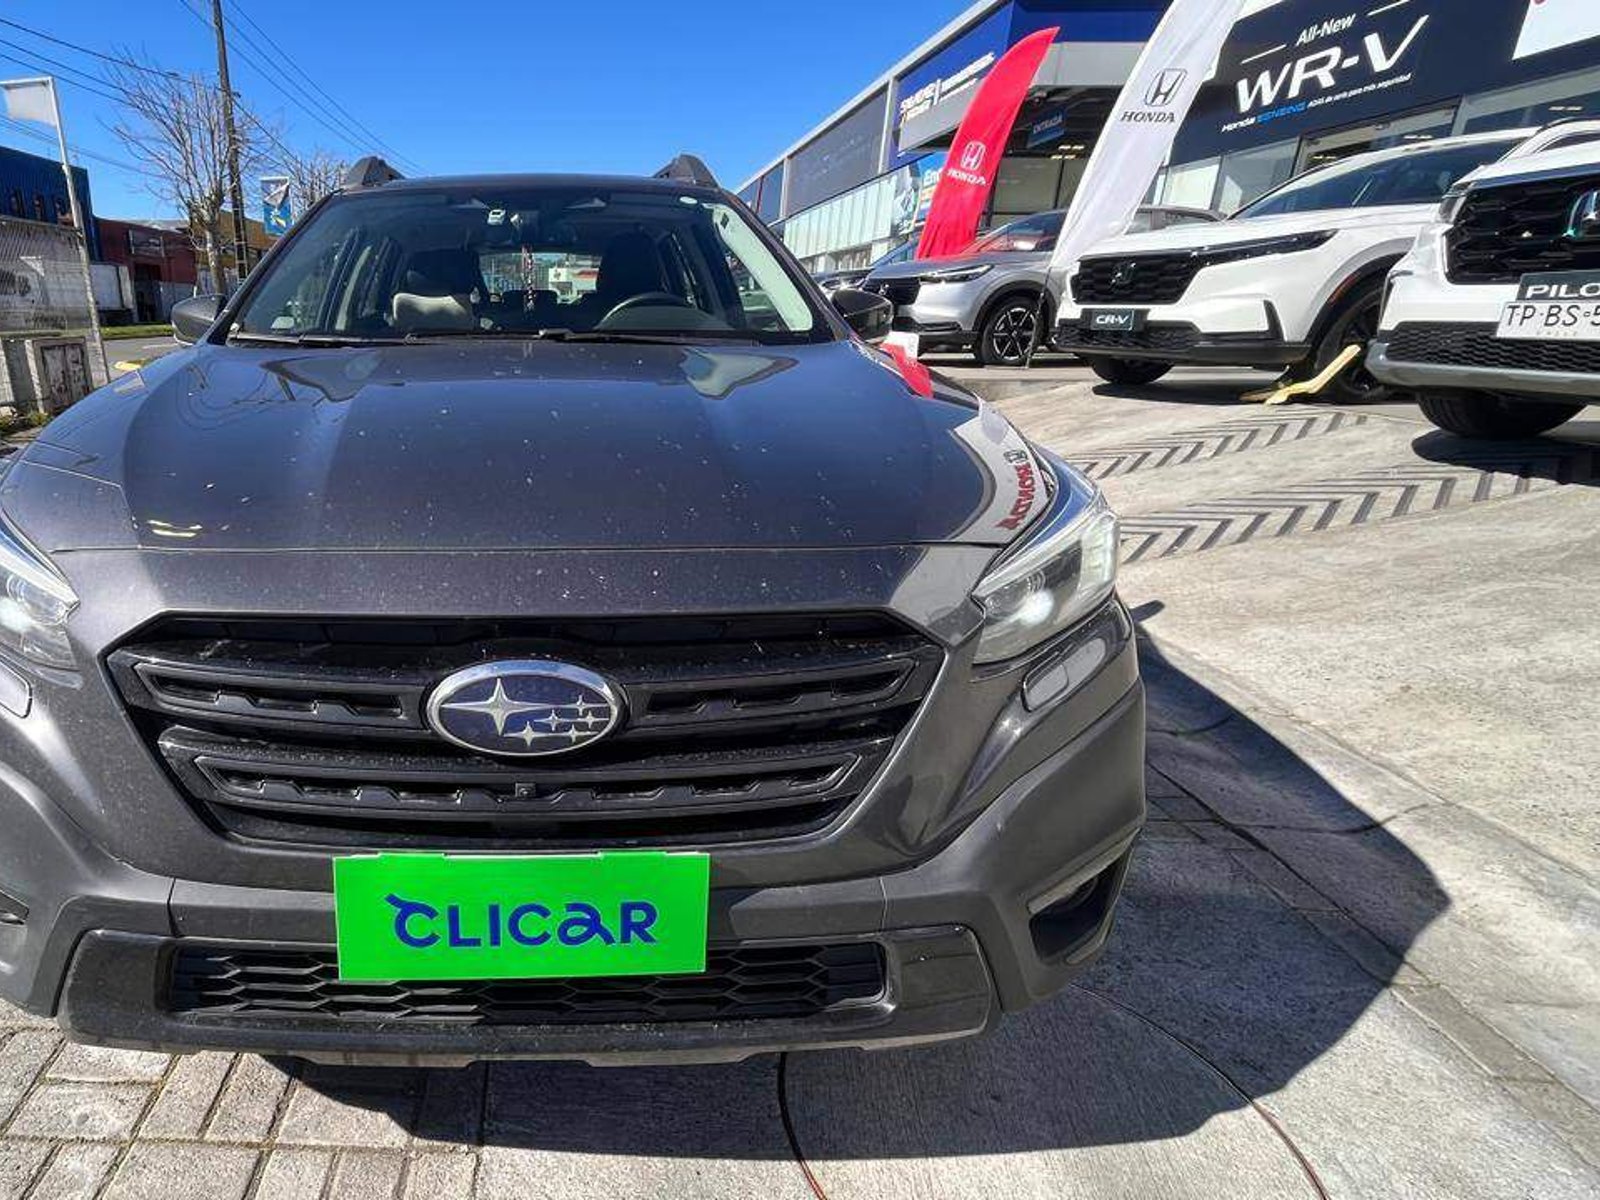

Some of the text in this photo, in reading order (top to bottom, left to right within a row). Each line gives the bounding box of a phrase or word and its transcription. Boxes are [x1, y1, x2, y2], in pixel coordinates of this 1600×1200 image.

[1295, 13, 1357, 46] All-New
[1236, 14, 1430, 113] WR-V
[1121, 111, 1176, 122] HONDA
[947, 167, 987, 187] HONDA
[1096, 314, 1130, 324] CR-V
